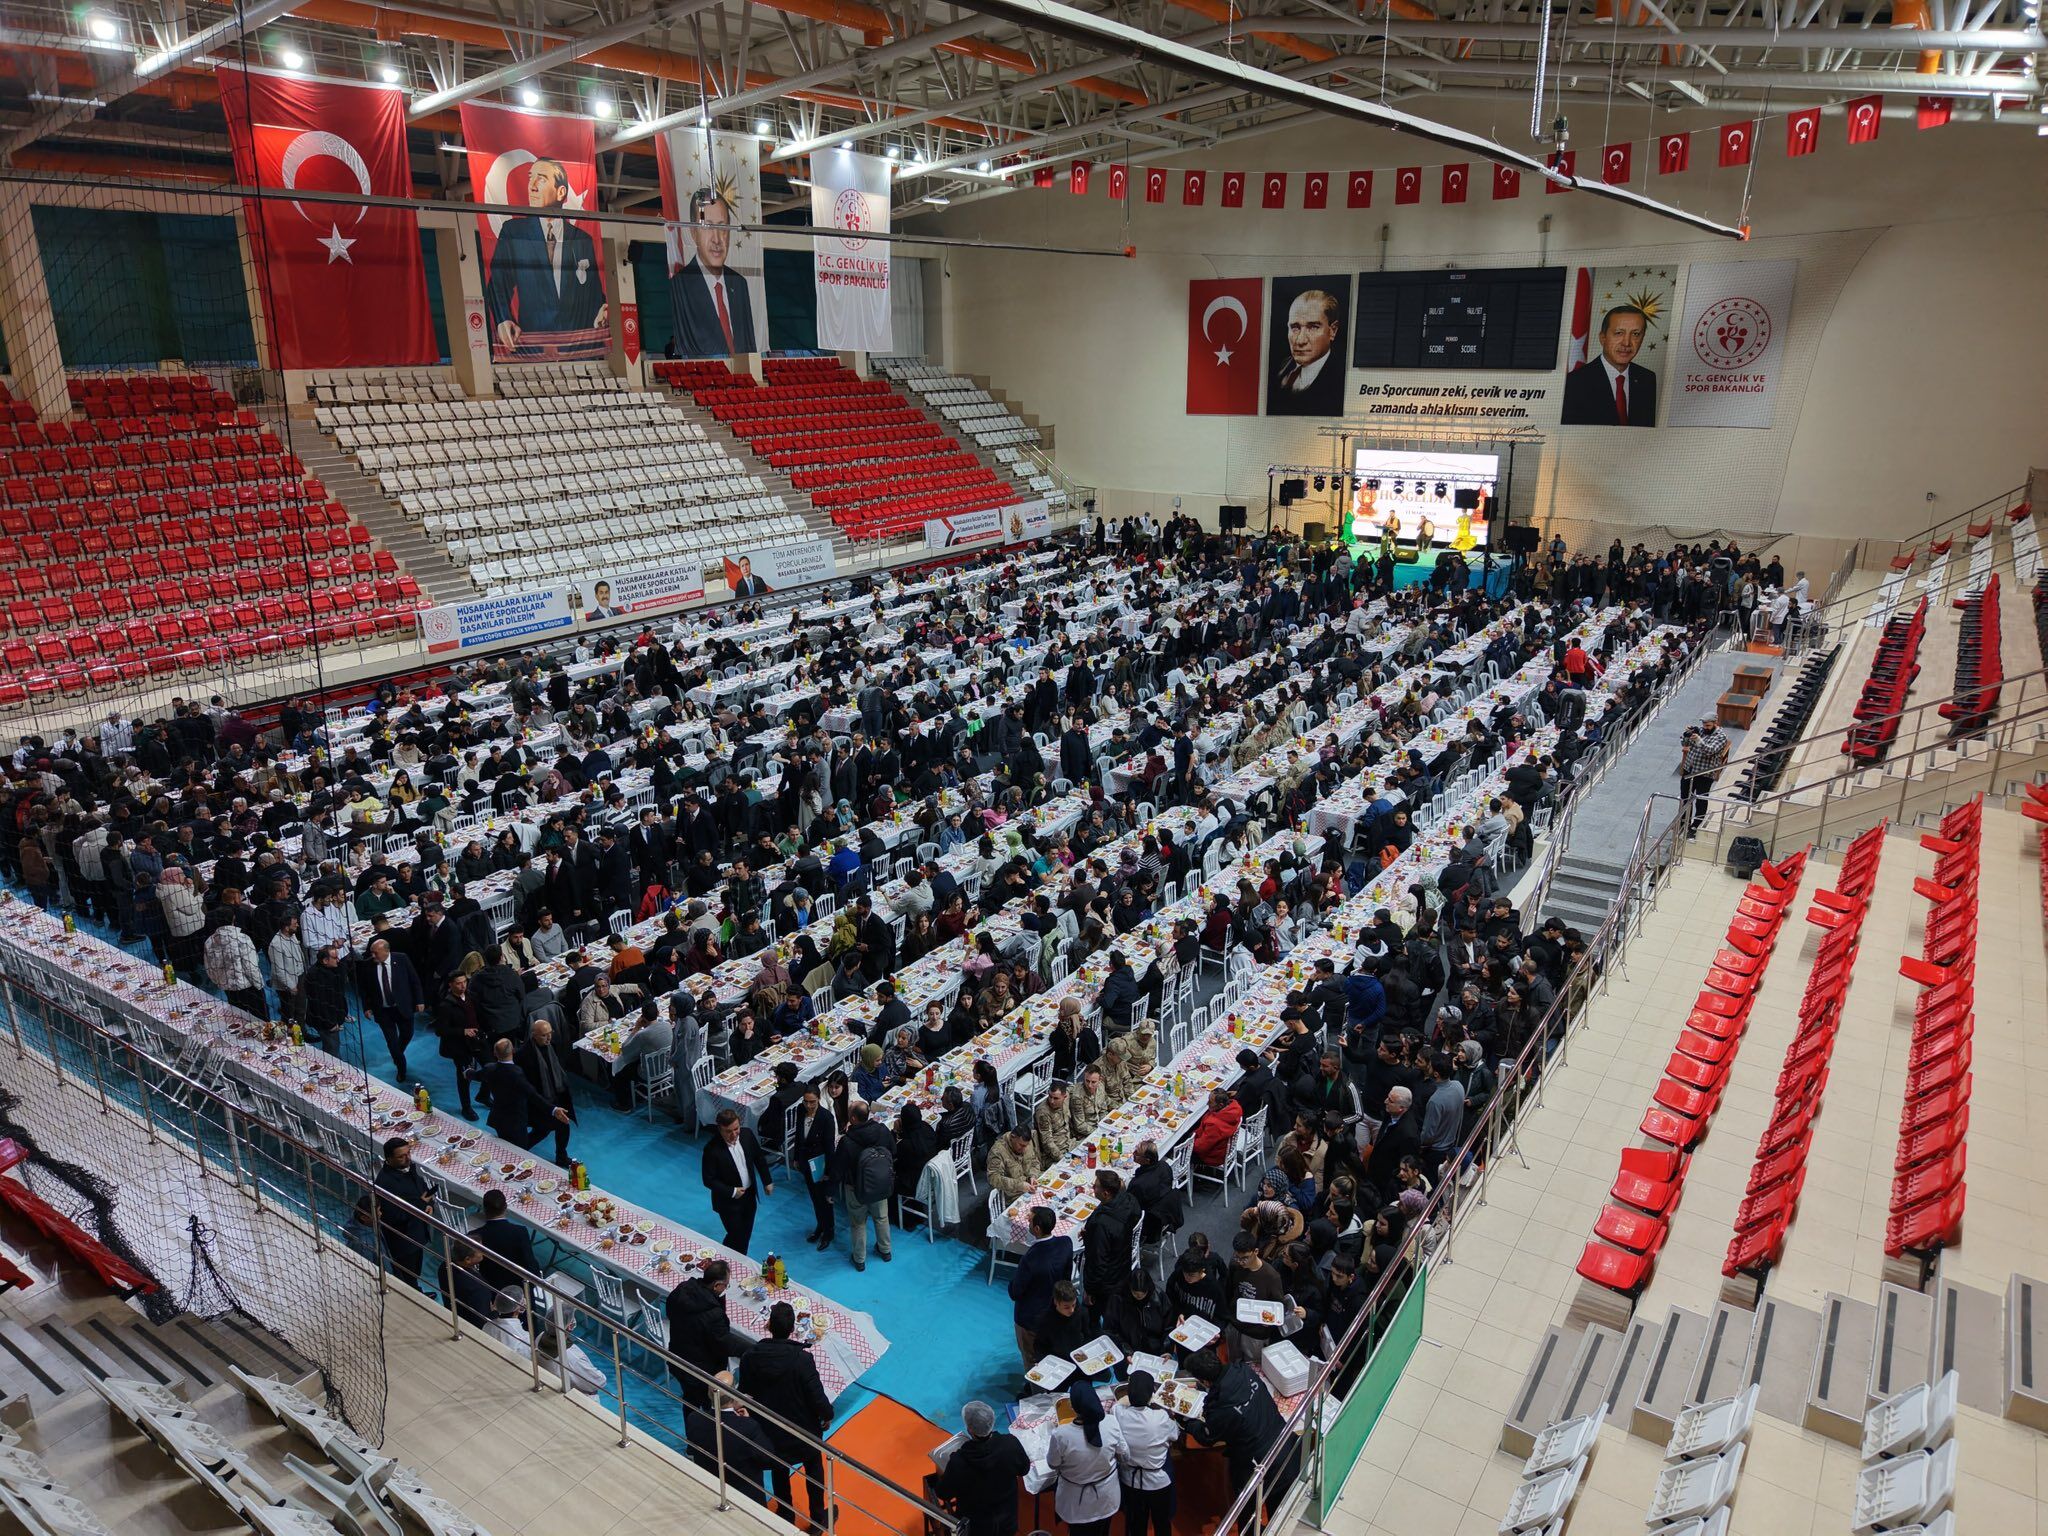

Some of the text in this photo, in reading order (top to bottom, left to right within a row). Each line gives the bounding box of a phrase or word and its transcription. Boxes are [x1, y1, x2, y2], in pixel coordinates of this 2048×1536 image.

[818, 255, 834, 268] T.C.
[878, 263, 888, 273] VE
[819, 271, 889, 289] SPOR BAKANLIĞI
[1429, 345, 1445, 353] SCORE
[1461, 345, 1477, 353] SCORE
[1685, 384, 1764, 392] SPOR BAKANLIĞI
[1706, 374, 1749, 384] GENÇLİK
[1359, 384, 1546, 401] Ben Sporcunun zeki, çevik ve aynı
[1369, 403, 1529, 418] zamanda ahlaklısını severim.
[615, 565, 696, 586] MÜSABAKALARA KATILAN
[616, 575, 689, 594] TAKIM VE SPORCULARA
[618, 590, 654, 602] BAŞARILAR
[655, 584, 680, 595] DİLERİM
[457, 592, 553, 616] MÜSABAKALARA KATILAN
[458, 602, 546, 625] TAKIM VE SPORCULARA
[460, 613, 536, 634] BAŞARILAR DİLERİM
[525, 625, 537, 633] SPOR
